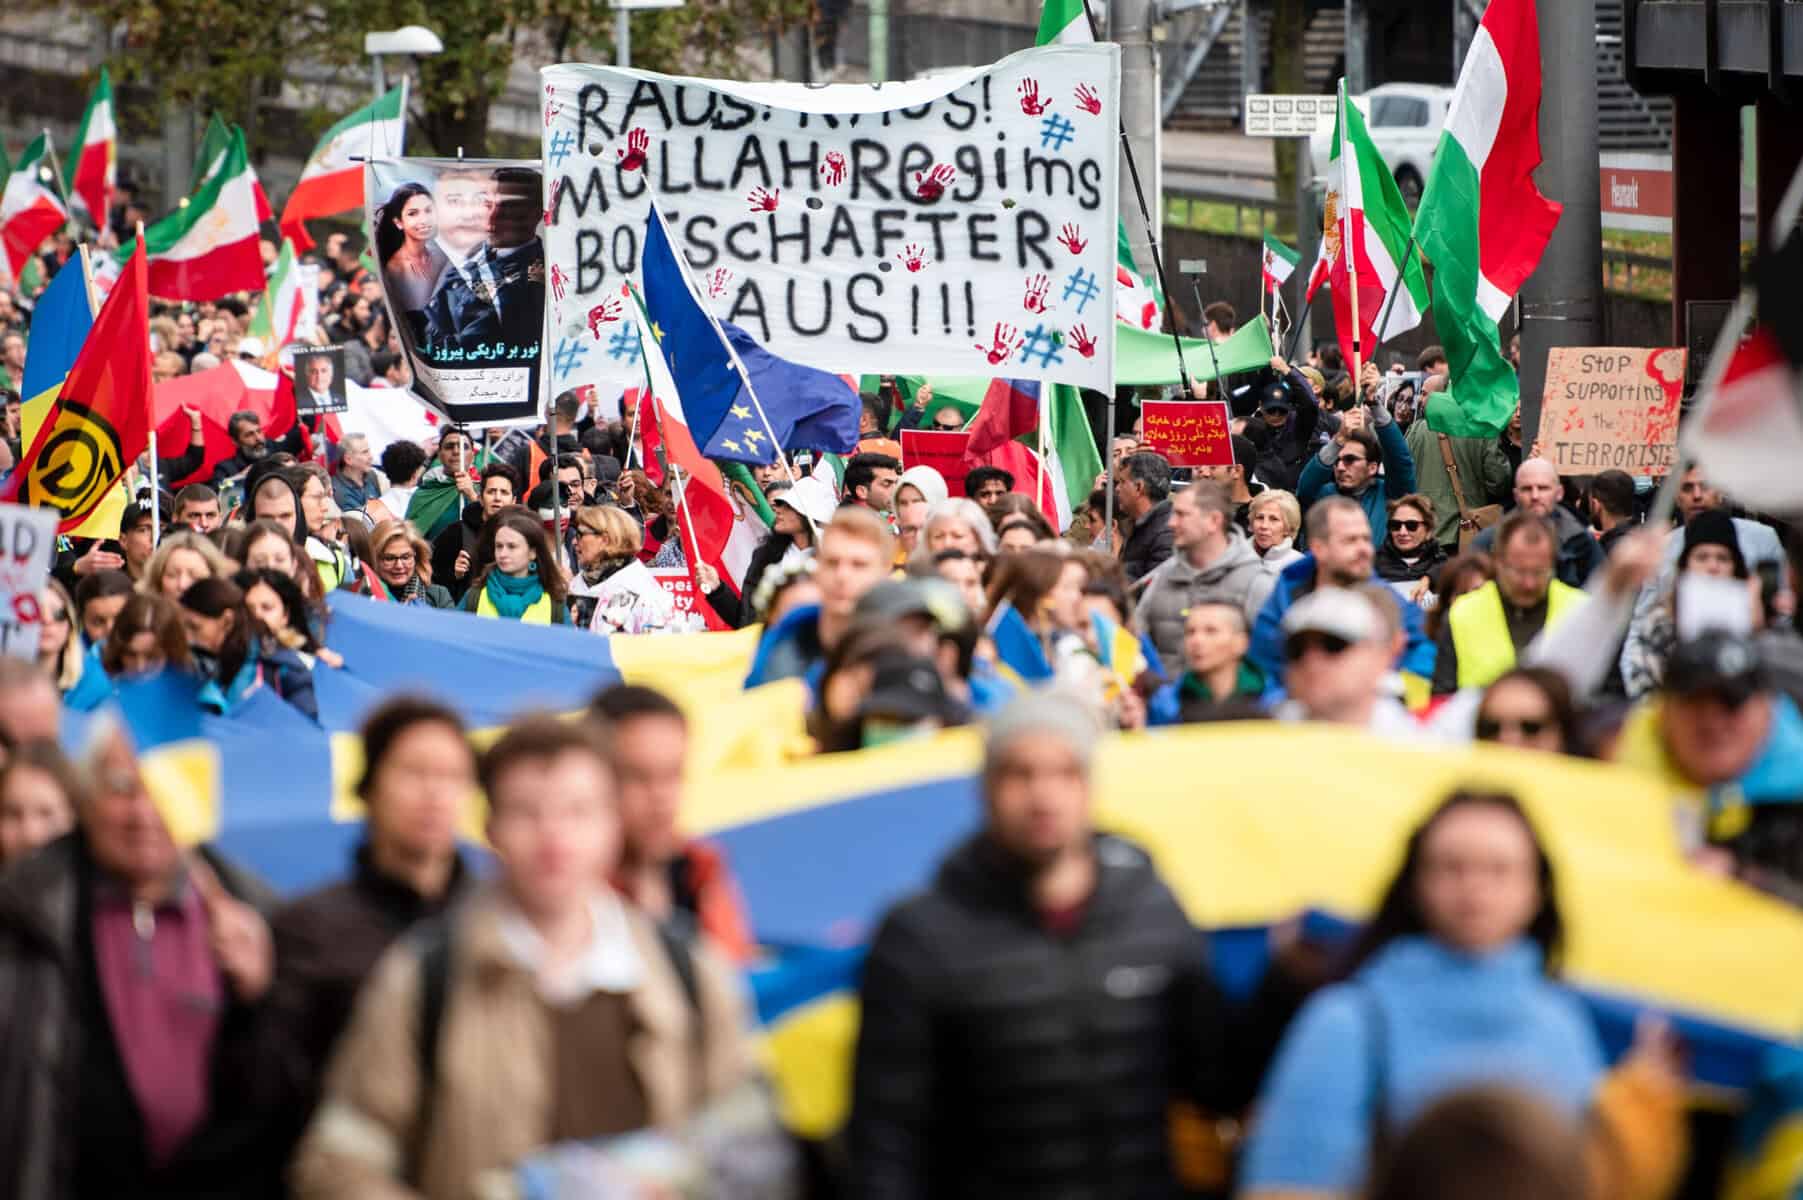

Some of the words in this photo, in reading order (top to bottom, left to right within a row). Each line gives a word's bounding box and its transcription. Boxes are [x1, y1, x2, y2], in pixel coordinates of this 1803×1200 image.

[849, 130, 1103, 211] Regims
[575, 204, 1054, 295] BOSCHAFTER
[506, 345, 519, 359] بر
[519, 340, 540, 359] نور
